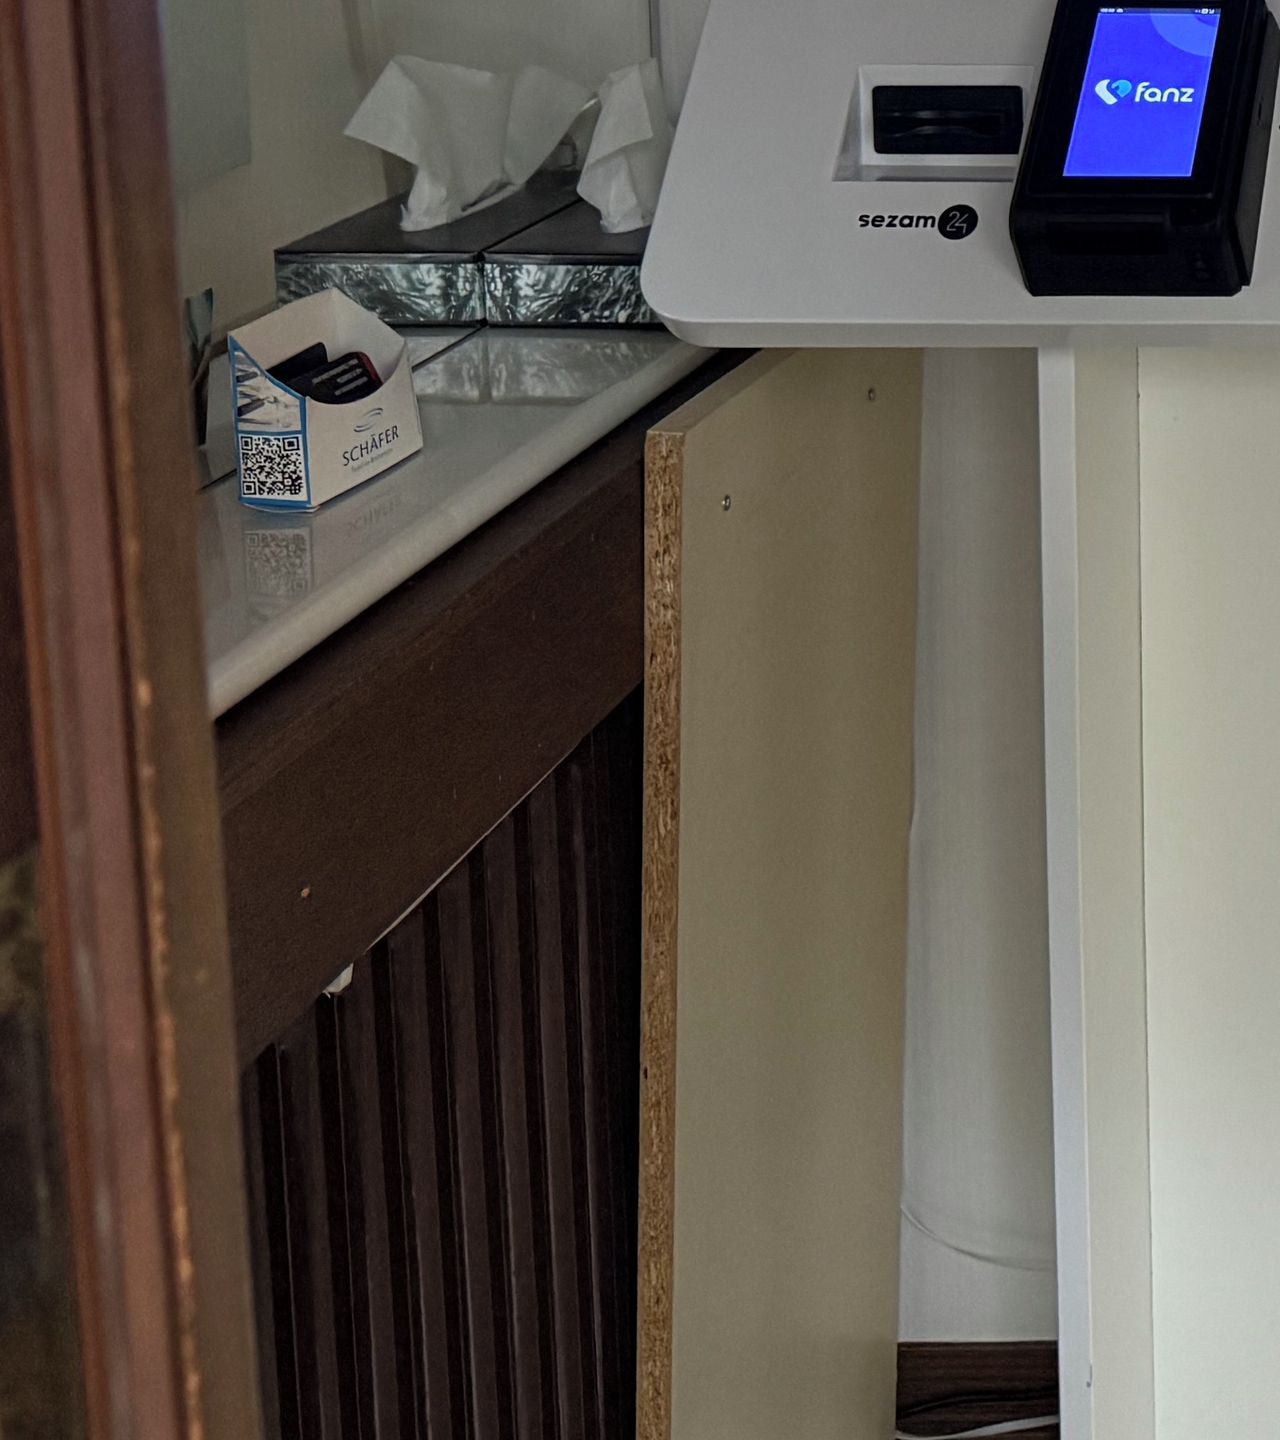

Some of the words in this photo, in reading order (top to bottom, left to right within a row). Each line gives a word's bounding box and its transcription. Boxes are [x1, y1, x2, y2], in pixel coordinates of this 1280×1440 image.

[1134, 81, 1194, 104] fanz
[858, 212, 936, 229] sezam
[946, 210, 971, 234] 24
[342, 425, 399, 467] SCHÄFER
